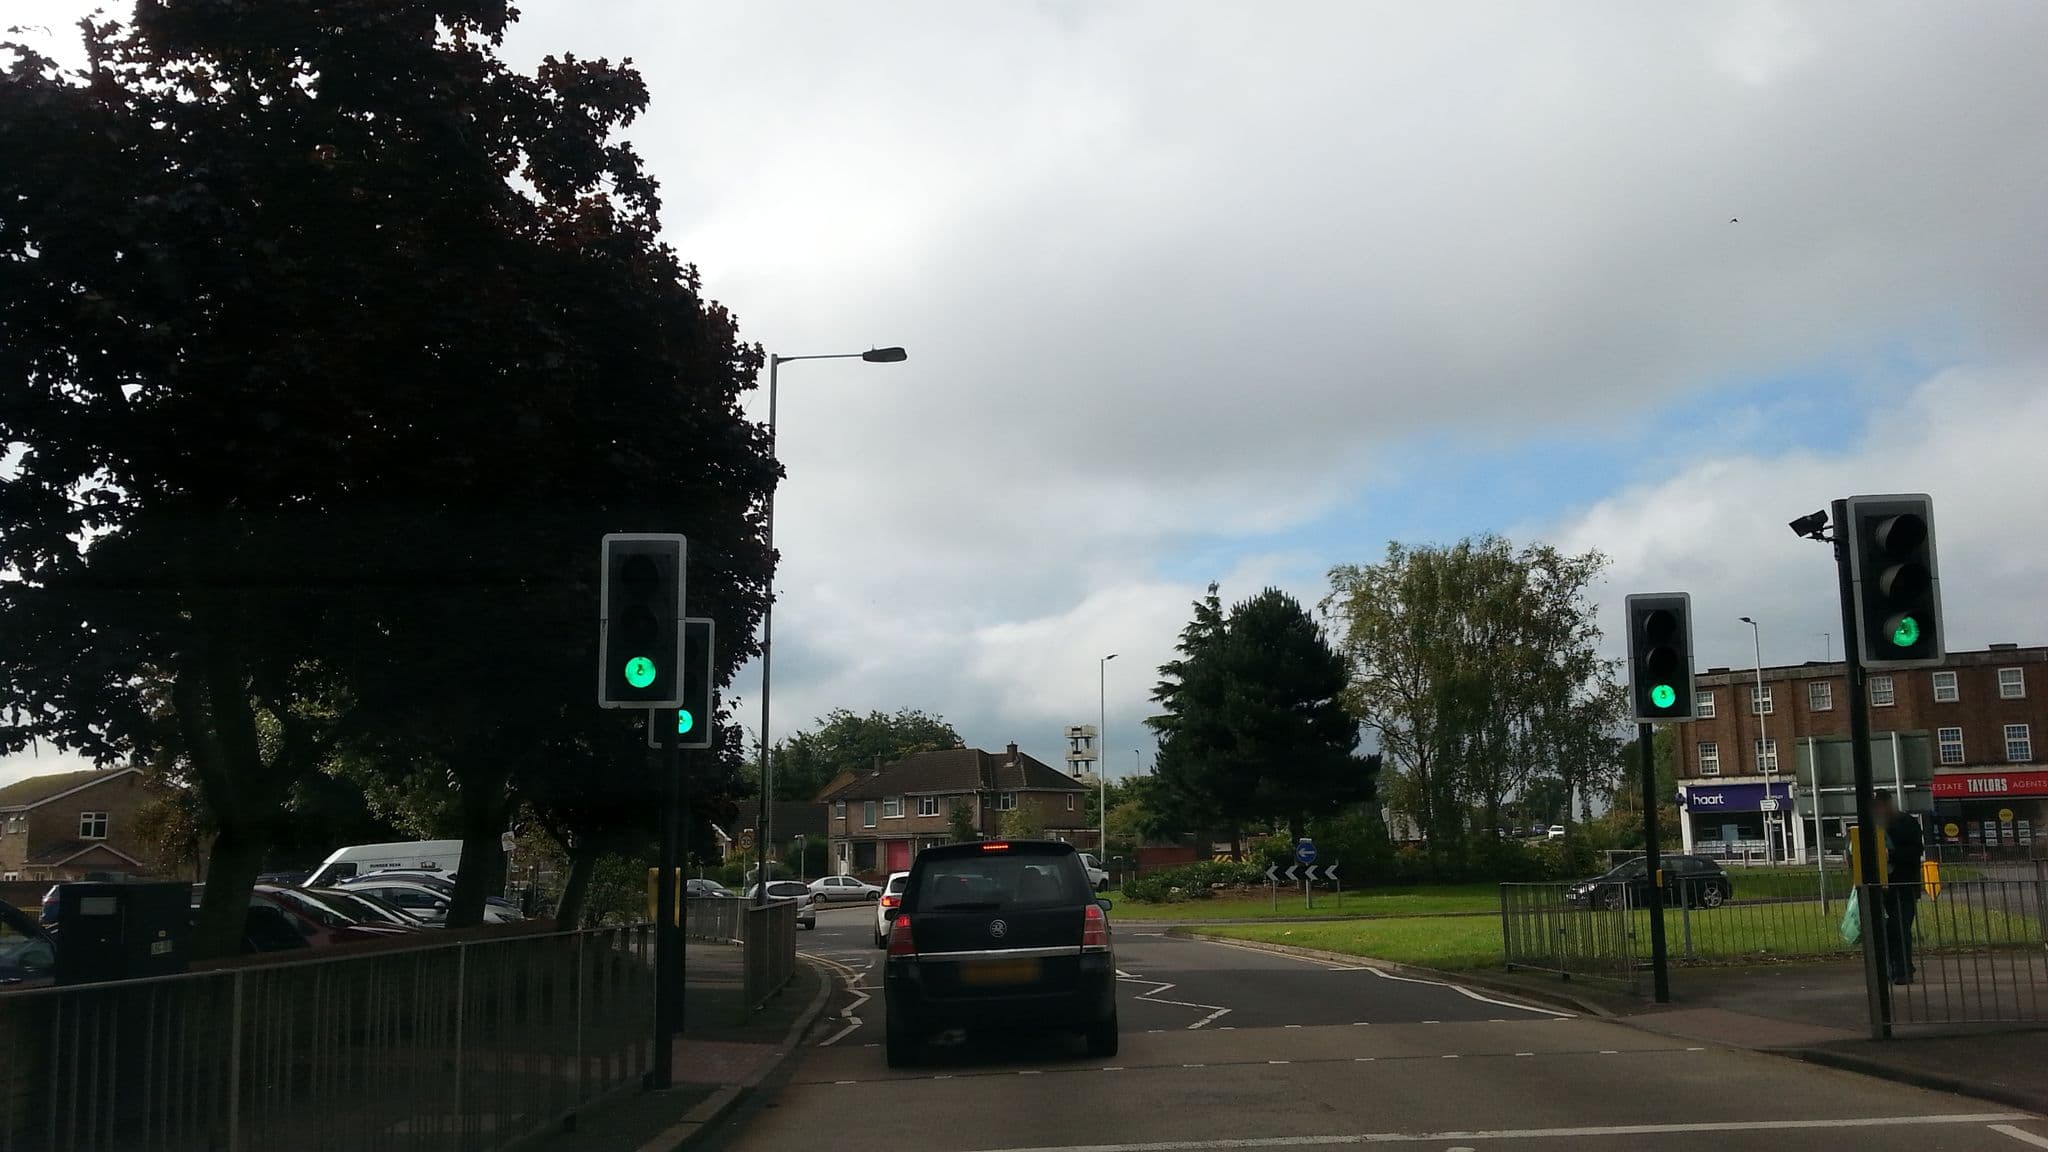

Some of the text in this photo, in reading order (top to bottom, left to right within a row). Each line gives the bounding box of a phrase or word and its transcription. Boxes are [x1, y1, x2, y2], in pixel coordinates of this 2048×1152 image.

[1931, 778, 2048, 793] ESTATE TAYLORS AGENTS
[1692, 793, 1725, 806] haart
